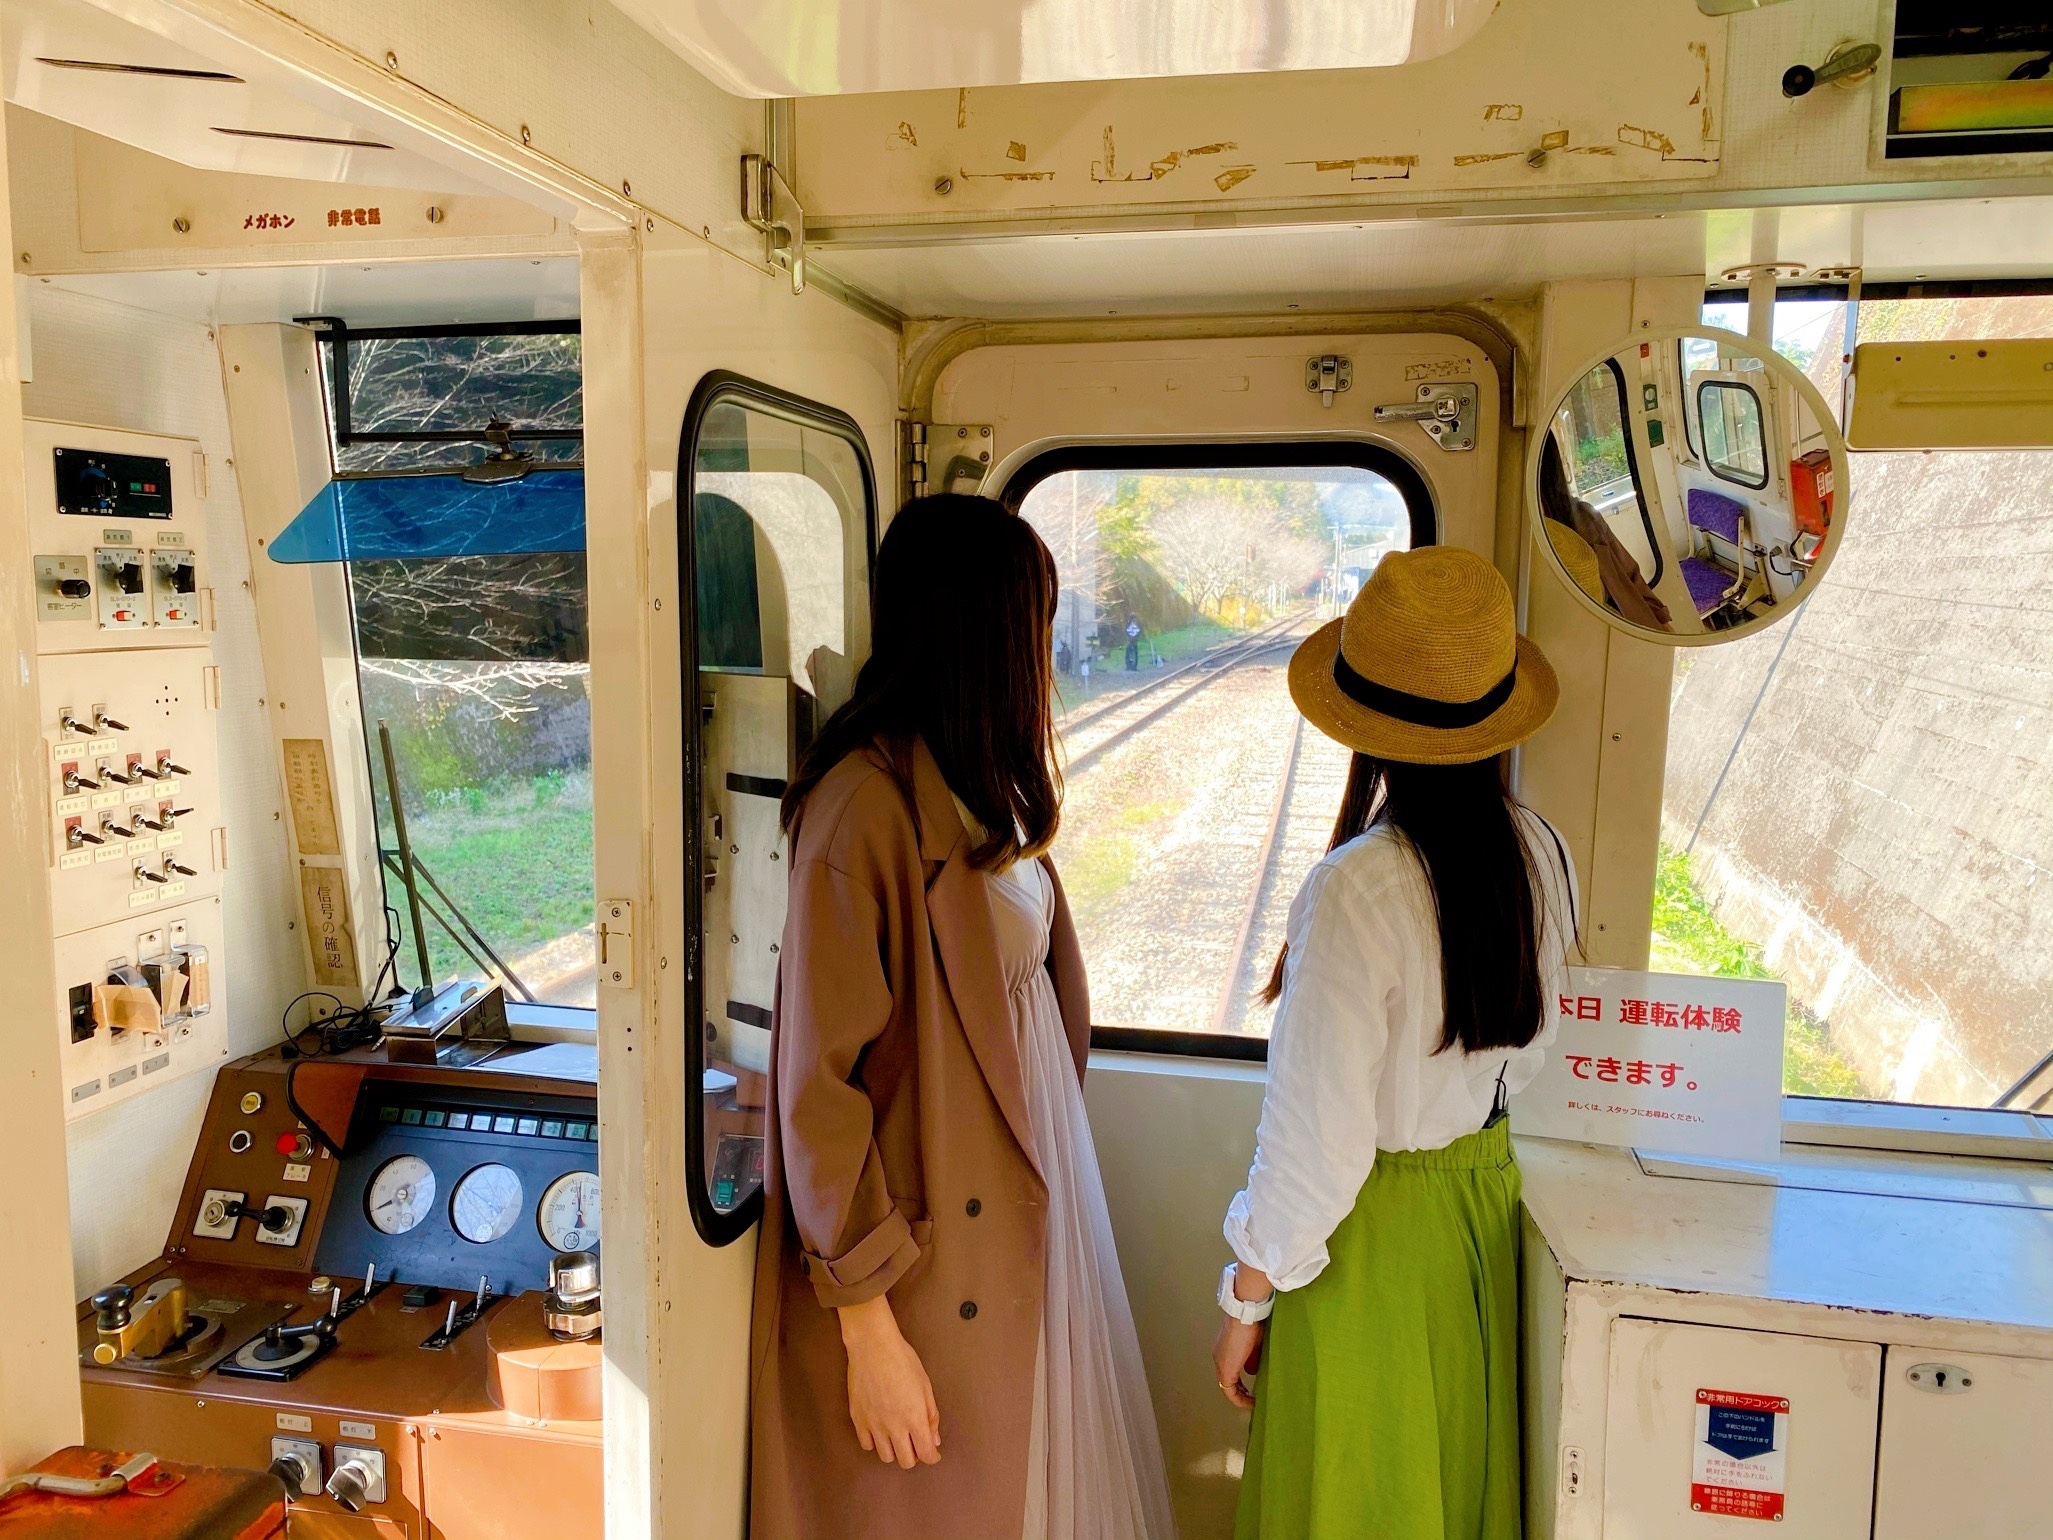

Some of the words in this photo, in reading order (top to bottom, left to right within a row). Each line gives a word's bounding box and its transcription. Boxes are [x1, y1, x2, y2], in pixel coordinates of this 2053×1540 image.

[243, 213, 295, 229] メガホン
[327, 208, 381, 227] 非常電話
[317, 886, 343, 968] 信号の確認
[1619, 998, 1742, 1034] 運転体験
[1565, 1054, 1698, 1091] できます。
[1567, 1101, 1706, 1123] 詳しくは、スタッフにお尋ねください。
[1707, 1393, 1780, 1409] 非常用ドアコック
